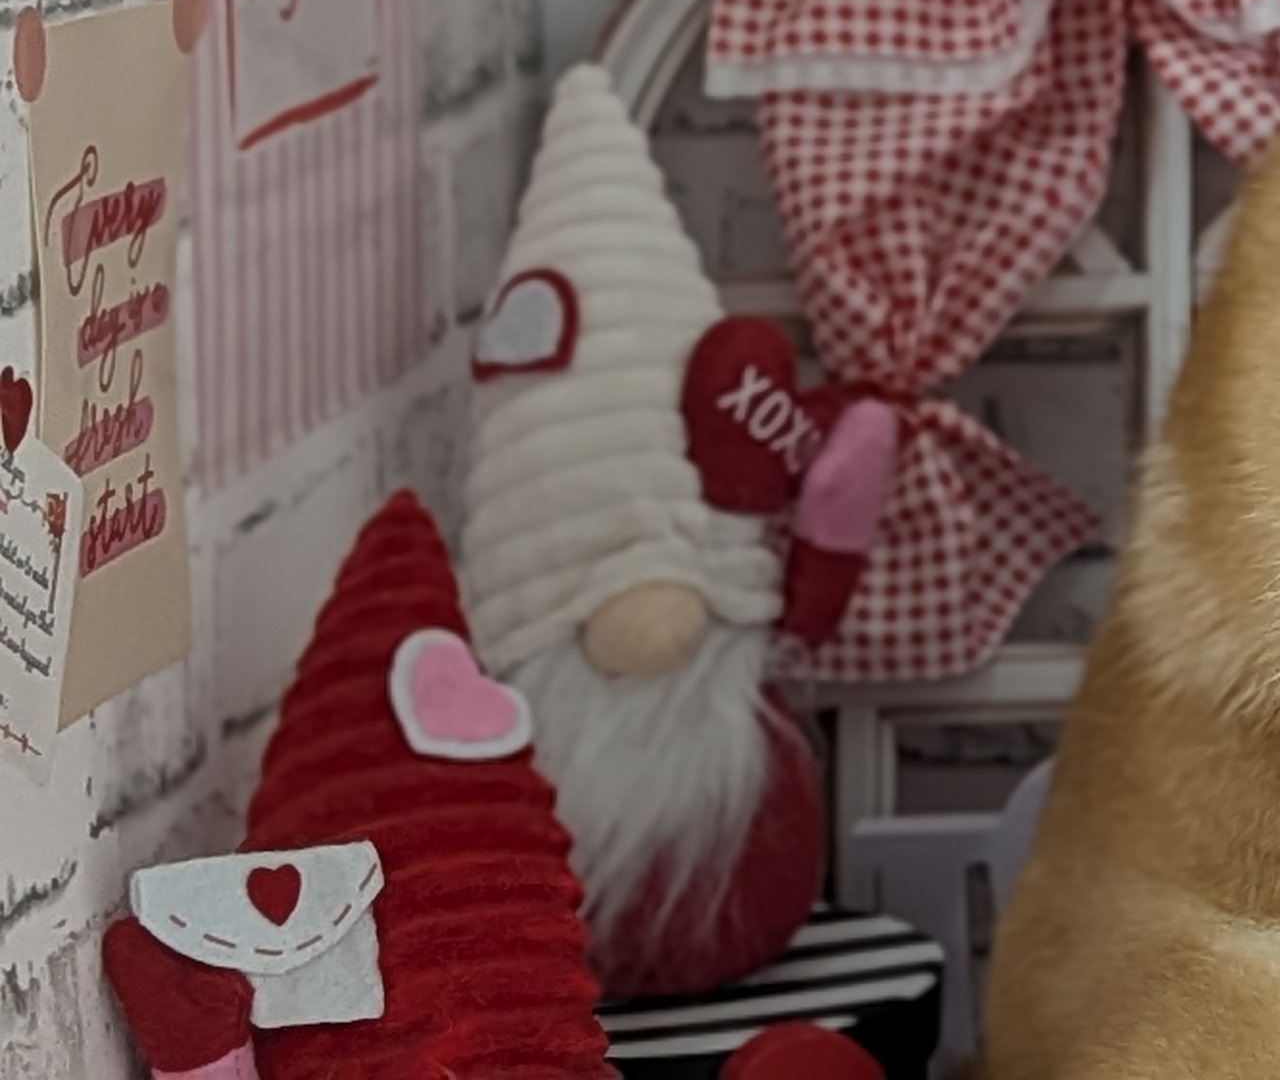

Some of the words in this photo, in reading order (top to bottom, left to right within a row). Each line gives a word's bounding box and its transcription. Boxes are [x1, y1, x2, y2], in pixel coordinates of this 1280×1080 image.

[45, 145, 161, 293] Every
[81, 263, 126, 393] day
[64, 349, 148, 472] fresh
[715, 363, 823, 475] XOX
[84, 453, 158, 571] start
